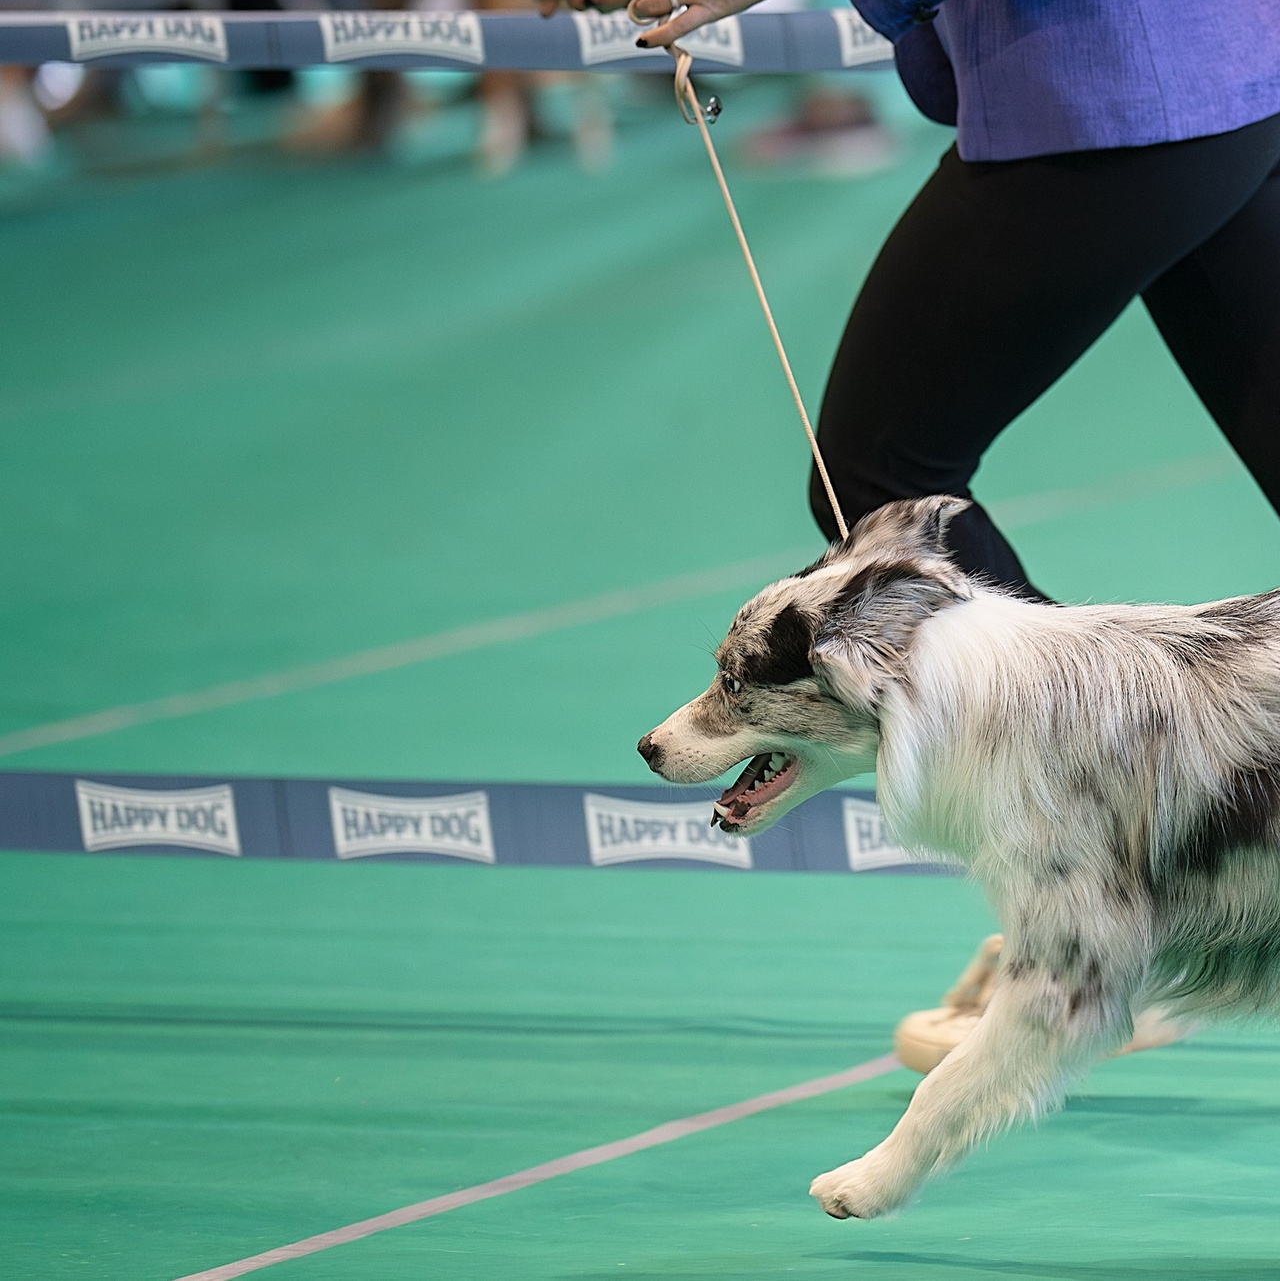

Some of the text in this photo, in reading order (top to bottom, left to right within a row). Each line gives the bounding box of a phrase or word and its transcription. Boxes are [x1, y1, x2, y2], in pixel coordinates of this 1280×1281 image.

[88, 798, 228, 838] HAPPY DOG
[341, 806, 482, 845] HAPPY DOG
[596, 813, 676, 848] HAPPY
